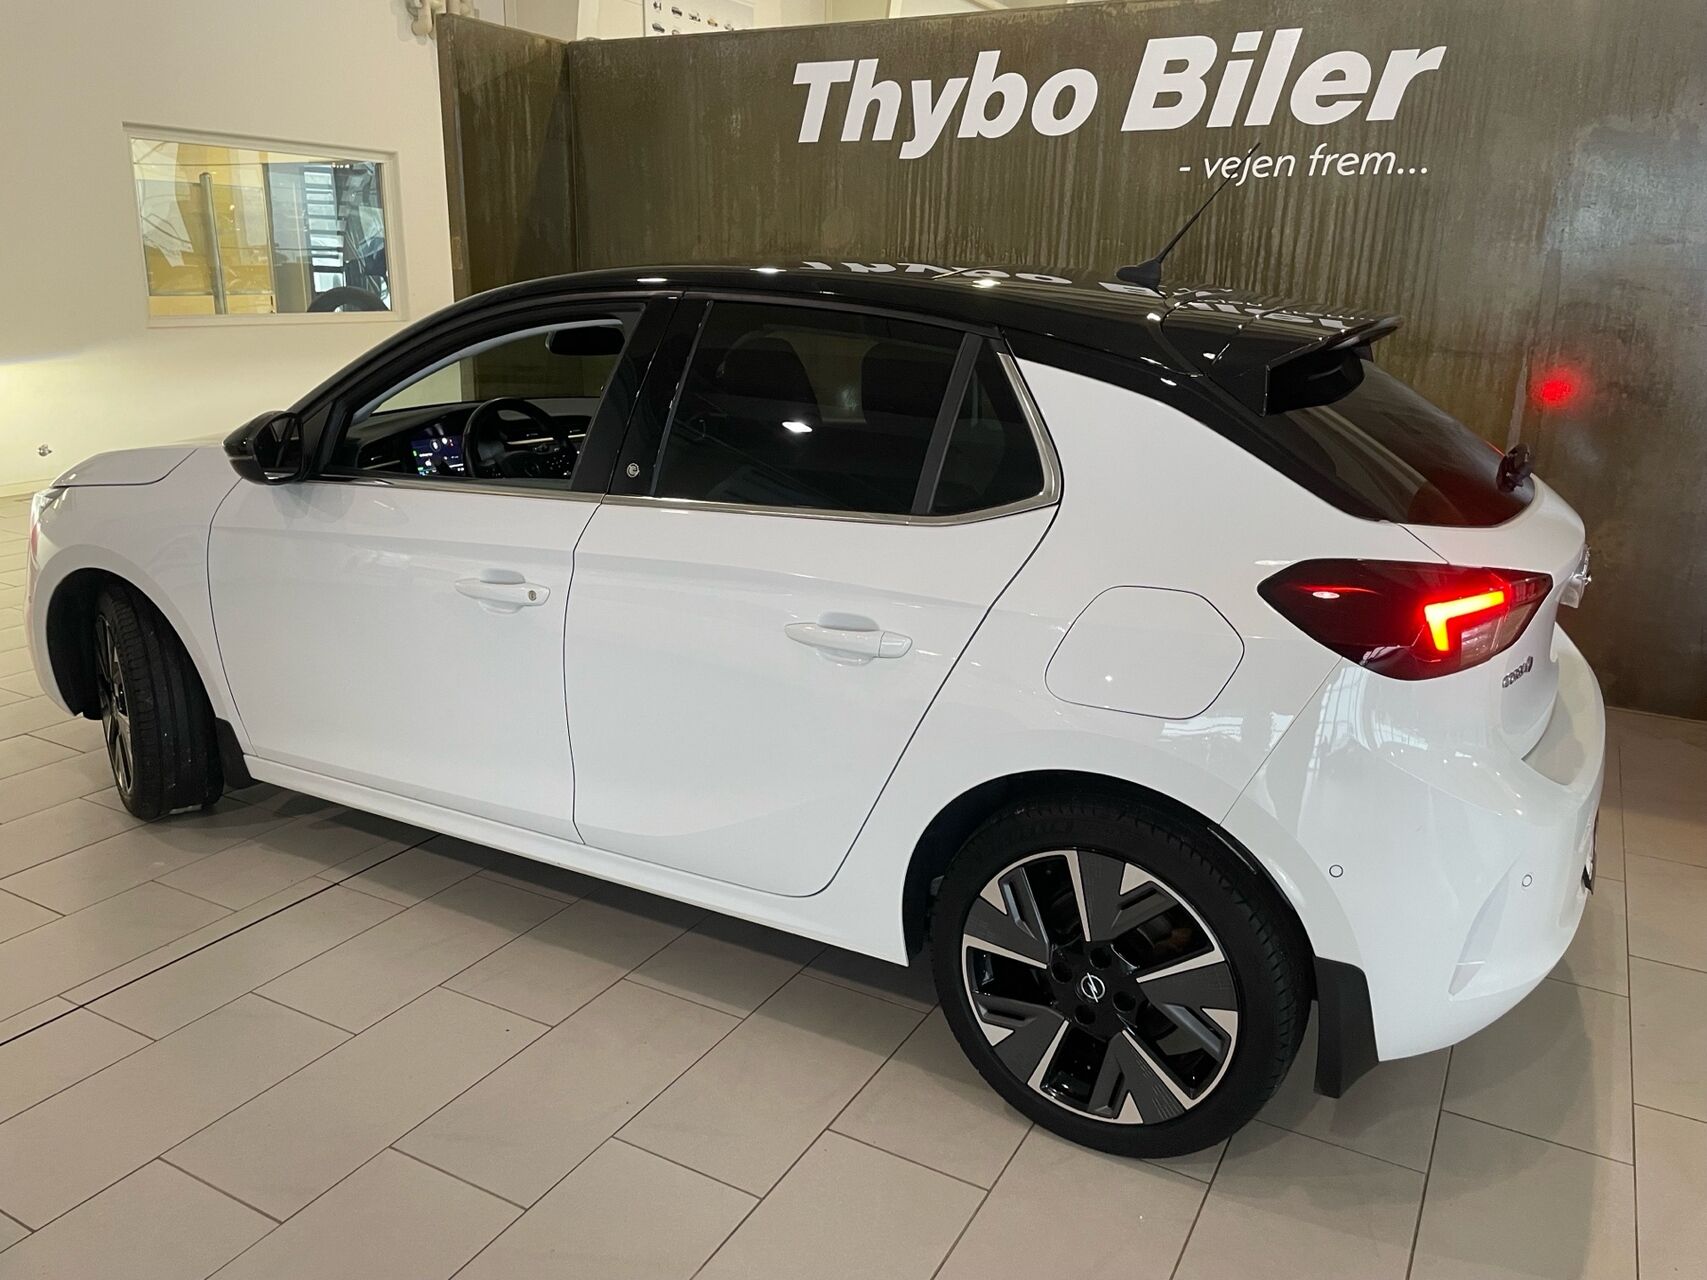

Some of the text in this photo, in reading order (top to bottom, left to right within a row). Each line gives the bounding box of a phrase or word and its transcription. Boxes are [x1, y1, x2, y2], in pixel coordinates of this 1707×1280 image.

[793, 27, 1447, 160] Thybo Biler
[1204, 155, 1296, 187] vejen
[1308, 142, 1429, 178] frem...
